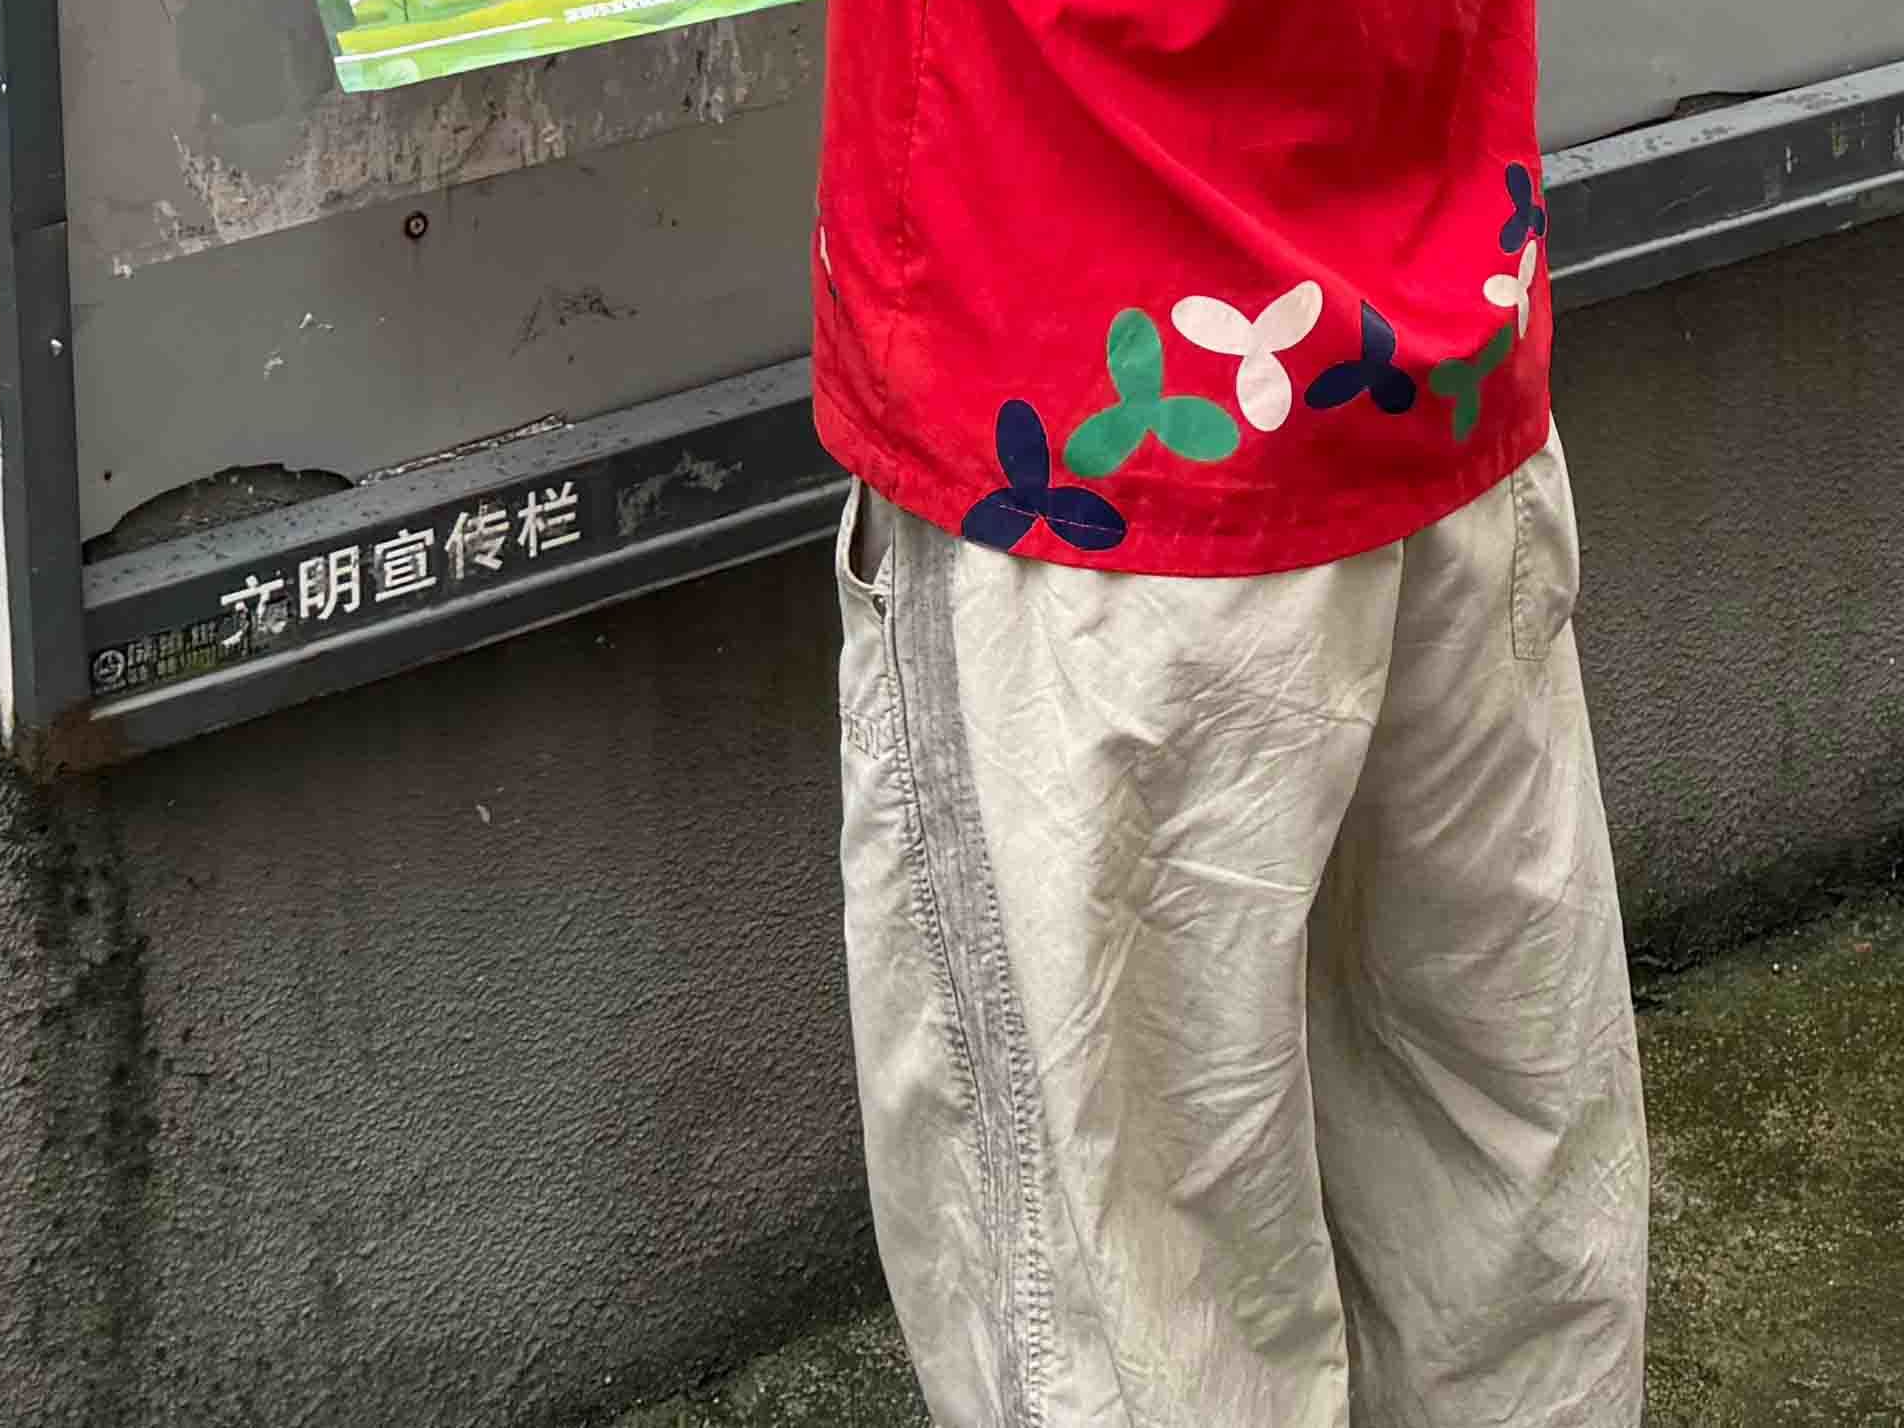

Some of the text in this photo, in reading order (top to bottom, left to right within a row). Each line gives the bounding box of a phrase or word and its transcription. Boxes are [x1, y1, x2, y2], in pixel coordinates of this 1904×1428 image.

[220, 480, 583, 647] 文明宣传栏
